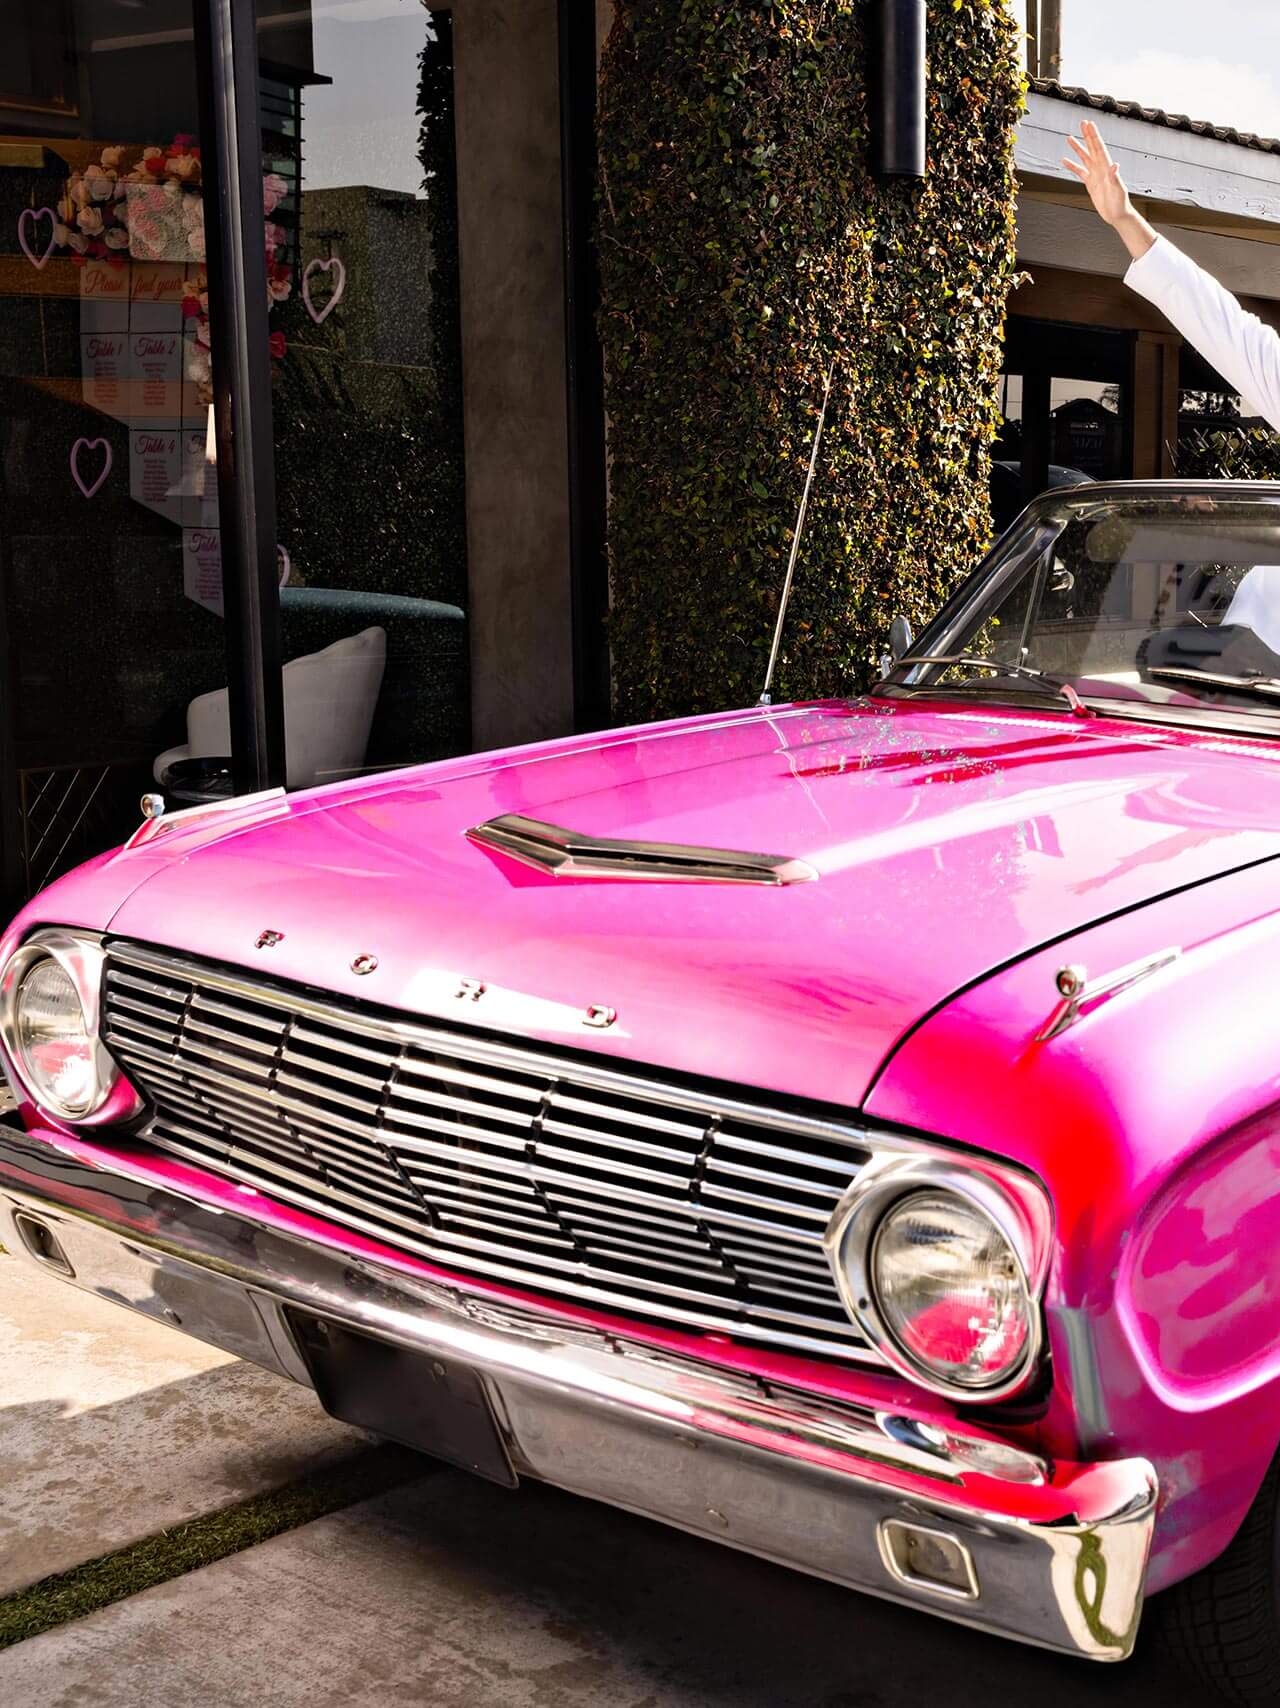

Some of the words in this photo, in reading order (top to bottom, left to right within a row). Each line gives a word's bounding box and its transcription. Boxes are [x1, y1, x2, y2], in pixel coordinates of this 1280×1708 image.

[85, 270, 123, 294] Please
[133, 273, 158, 299] find
[153, 276, 183, 301] your
[86, 338, 114, 359] Table
[117, 343, 123, 356] 1
[134, 336, 165, 357] Table
[167, 335, 176, 355] 2
[135, 434, 165, 455] Table
[168, 438, 177, 455] 4
[253, 928, 618, 1030] FORD
